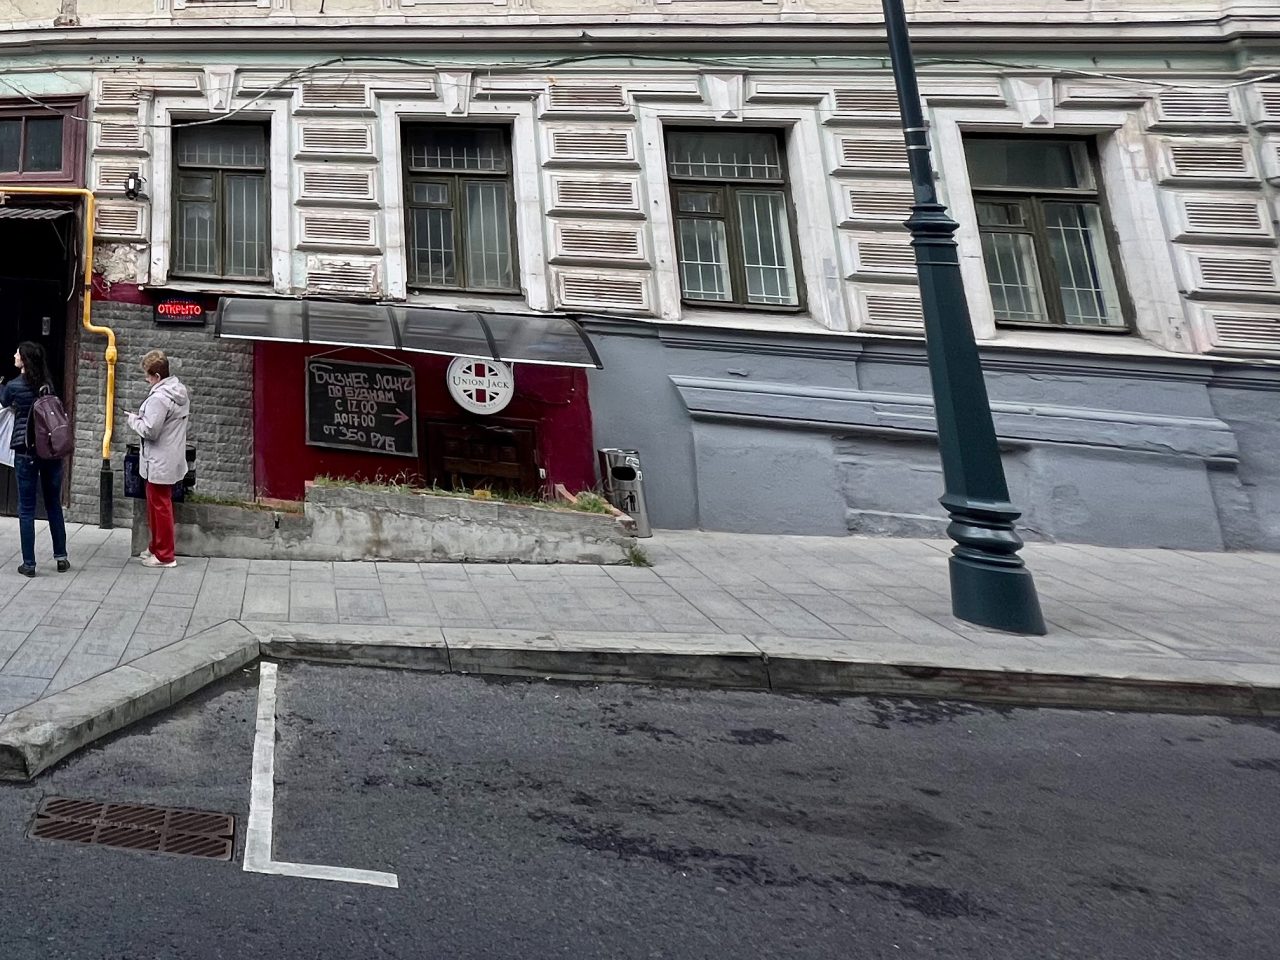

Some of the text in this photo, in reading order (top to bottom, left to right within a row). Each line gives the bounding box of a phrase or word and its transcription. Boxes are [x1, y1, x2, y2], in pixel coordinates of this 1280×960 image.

[158, 304, 201, 315] ОТКРЫТО
[328, 385, 395, 402] ПО БУДНЯМ
[323, 425, 396, 454] ОТ 350 РУБ
